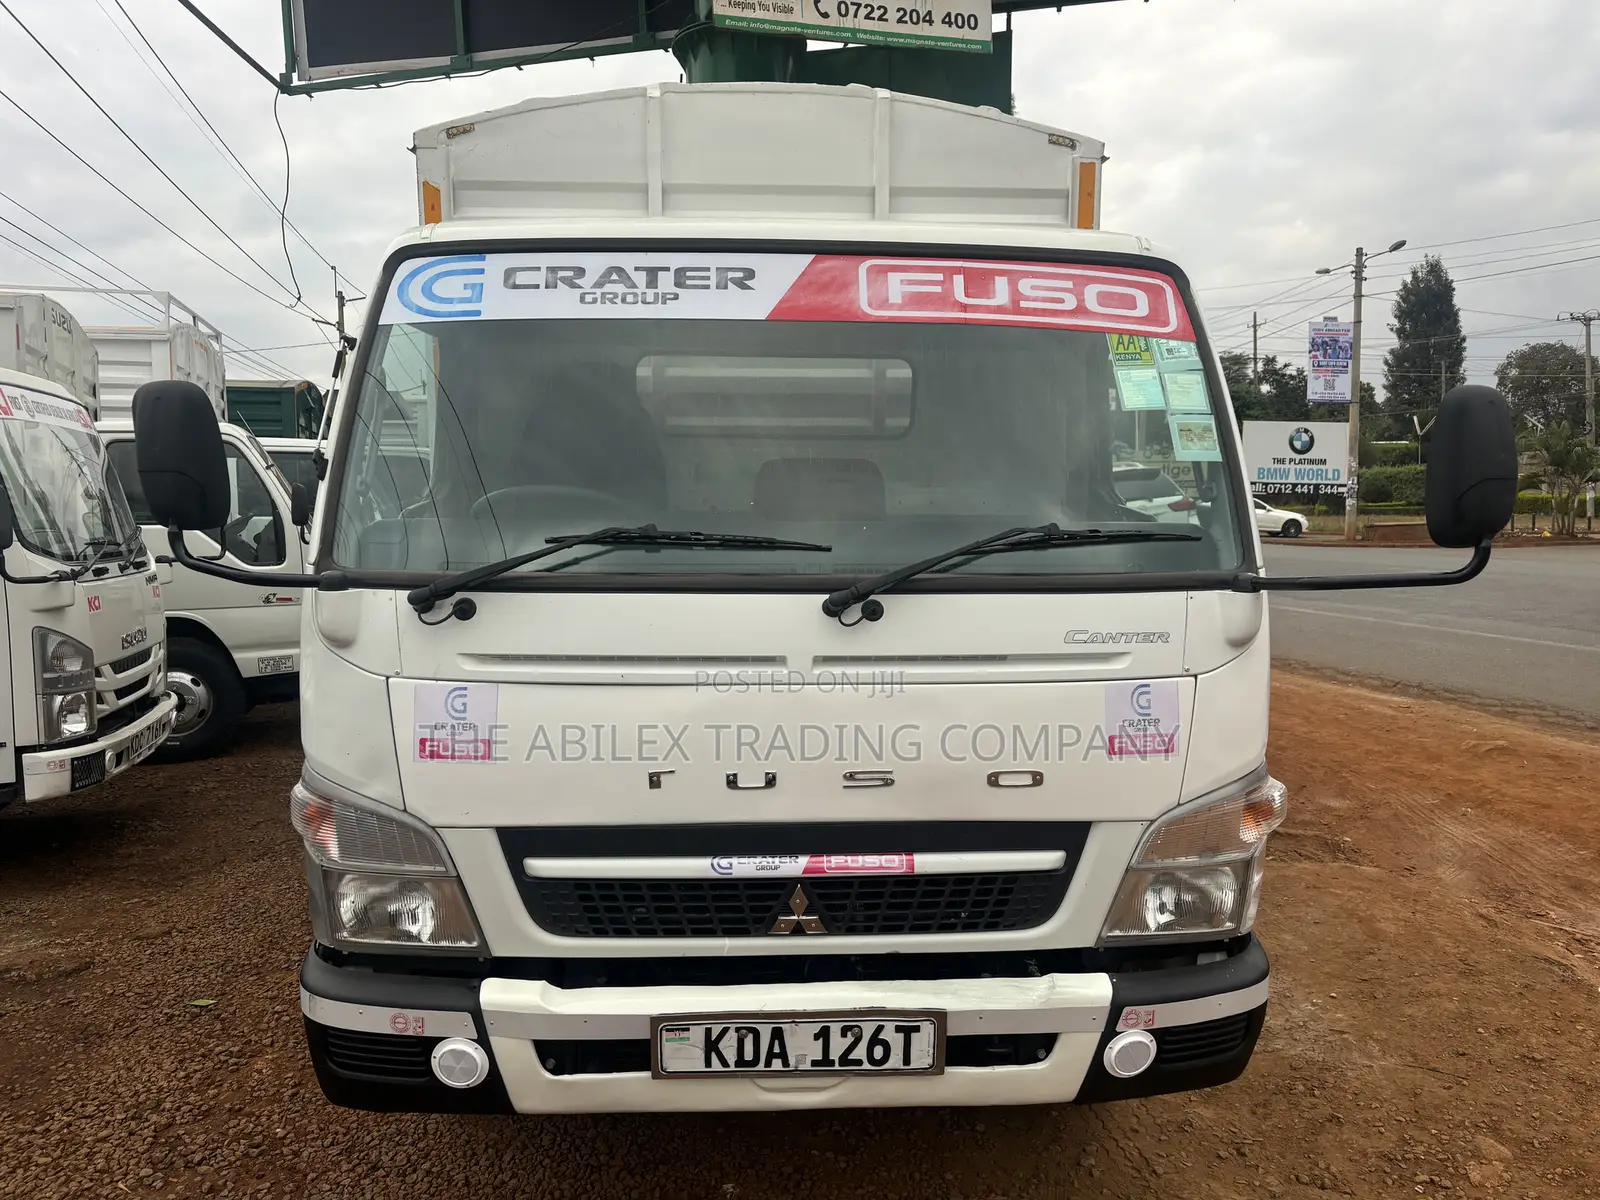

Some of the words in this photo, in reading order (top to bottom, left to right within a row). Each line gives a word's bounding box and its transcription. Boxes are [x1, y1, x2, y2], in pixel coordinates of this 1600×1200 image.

[728, 0, 756, 13] Keeping
[758, 1, 770, 11] You
[772, 2, 795, 14] Visible
[837, 0, 889, 22] 0722
[896, 7, 934, 26] 204
[941, 11, 979, 30] 400
[725, 19, 749, 28] Email:
[857, 32, 886, 42] Website:
[887, 37, 982, 50] www.magnate-ventures.com
[502, 265, 756, 291] CRATER
[579, 291, 681, 305] GROUP
[887, 272, 1151, 317] FUSO
[1289, 458, 1327, 466] PLATINUM
[1257, 467, 1290, 480] BMW
[1294, 468, 1340, 481] WORLD
[1251, 483, 1266, 492] all:
[1267, 484, 1292, 493] 0712
[1295, 485, 1314, 493] 441
[1319, 485, 1338, 494] 344
[1063, 630, 1170, 644] CANTER
[425, 741, 485, 756] FUSO
[736, 855, 800, 865] CRATER
[830, 854, 900, 868] FUSO
[704, 1026, 791, 1069] KDA
[811, 1024, 921, 1068] 126T
